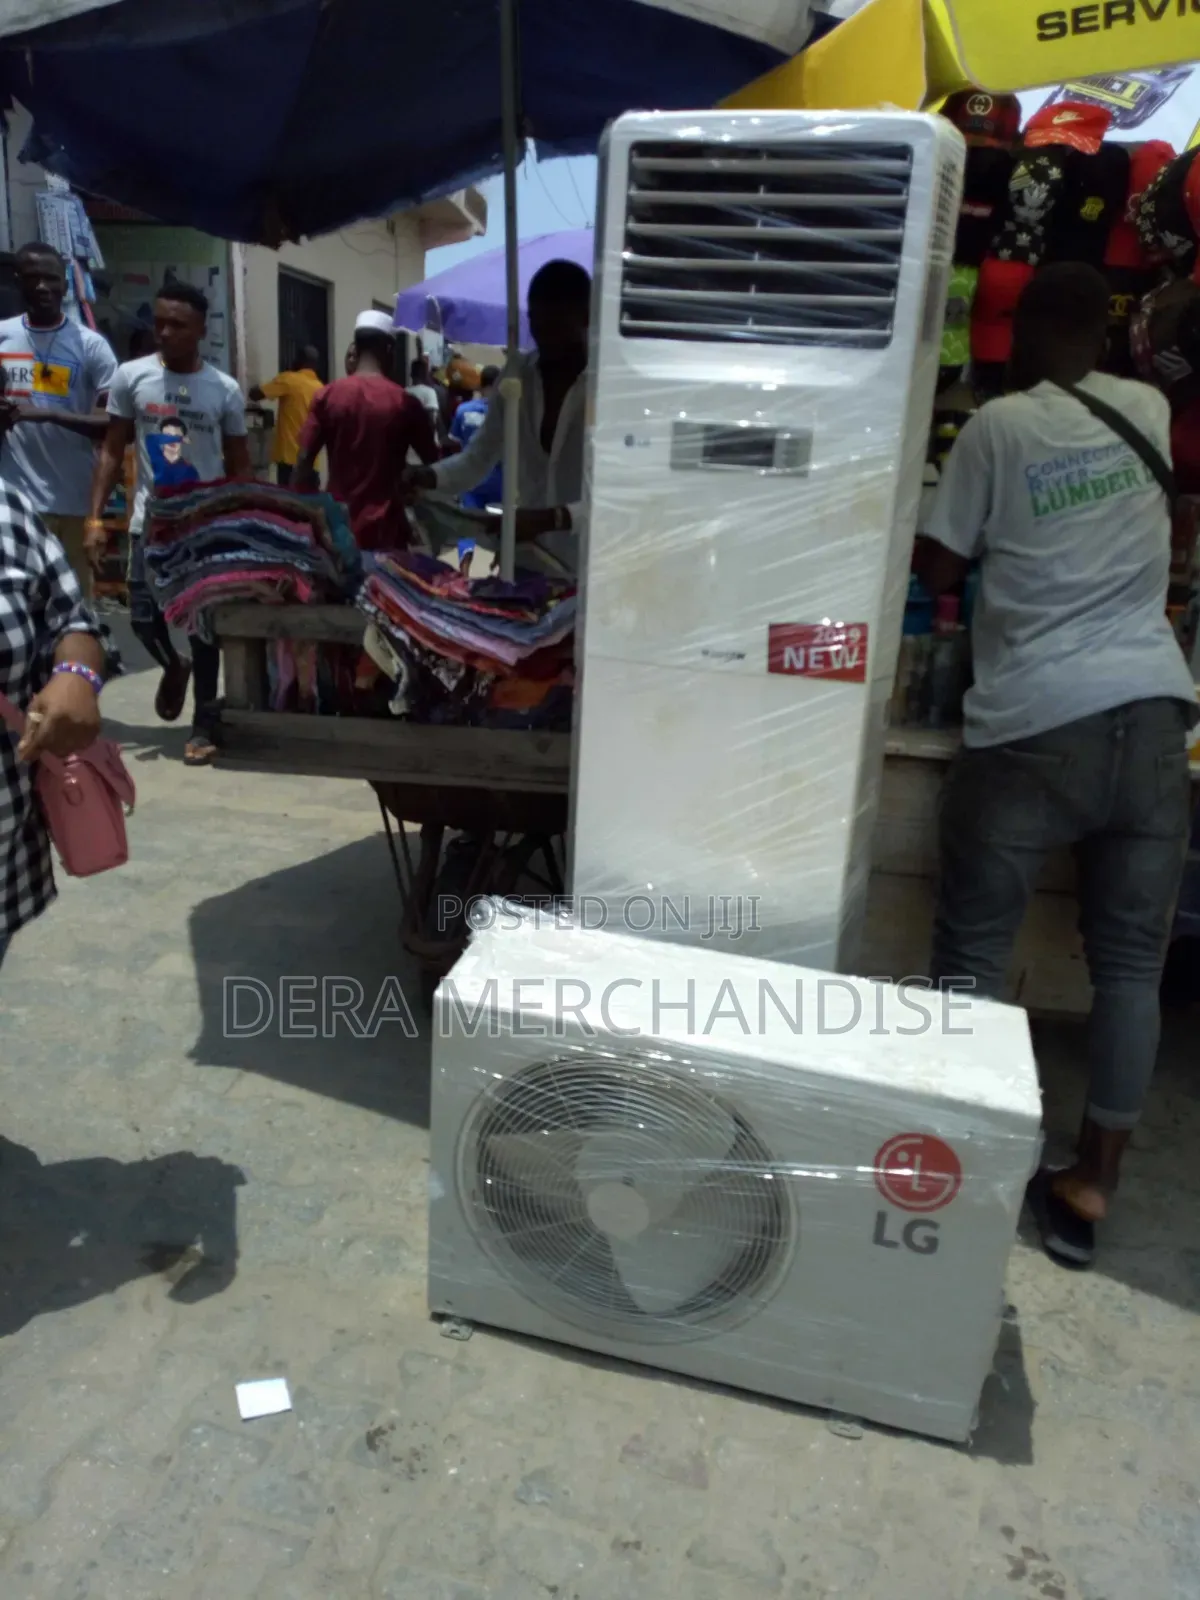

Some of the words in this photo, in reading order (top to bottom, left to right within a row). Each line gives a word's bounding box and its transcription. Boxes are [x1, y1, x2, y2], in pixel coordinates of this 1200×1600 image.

[1036, 0, 1200, 42] SERVI
[1031, 467, 1142, 518] LUMBER
[783, 646, 859, 669] NEW
[872, 1210, 940, 1255] LG
